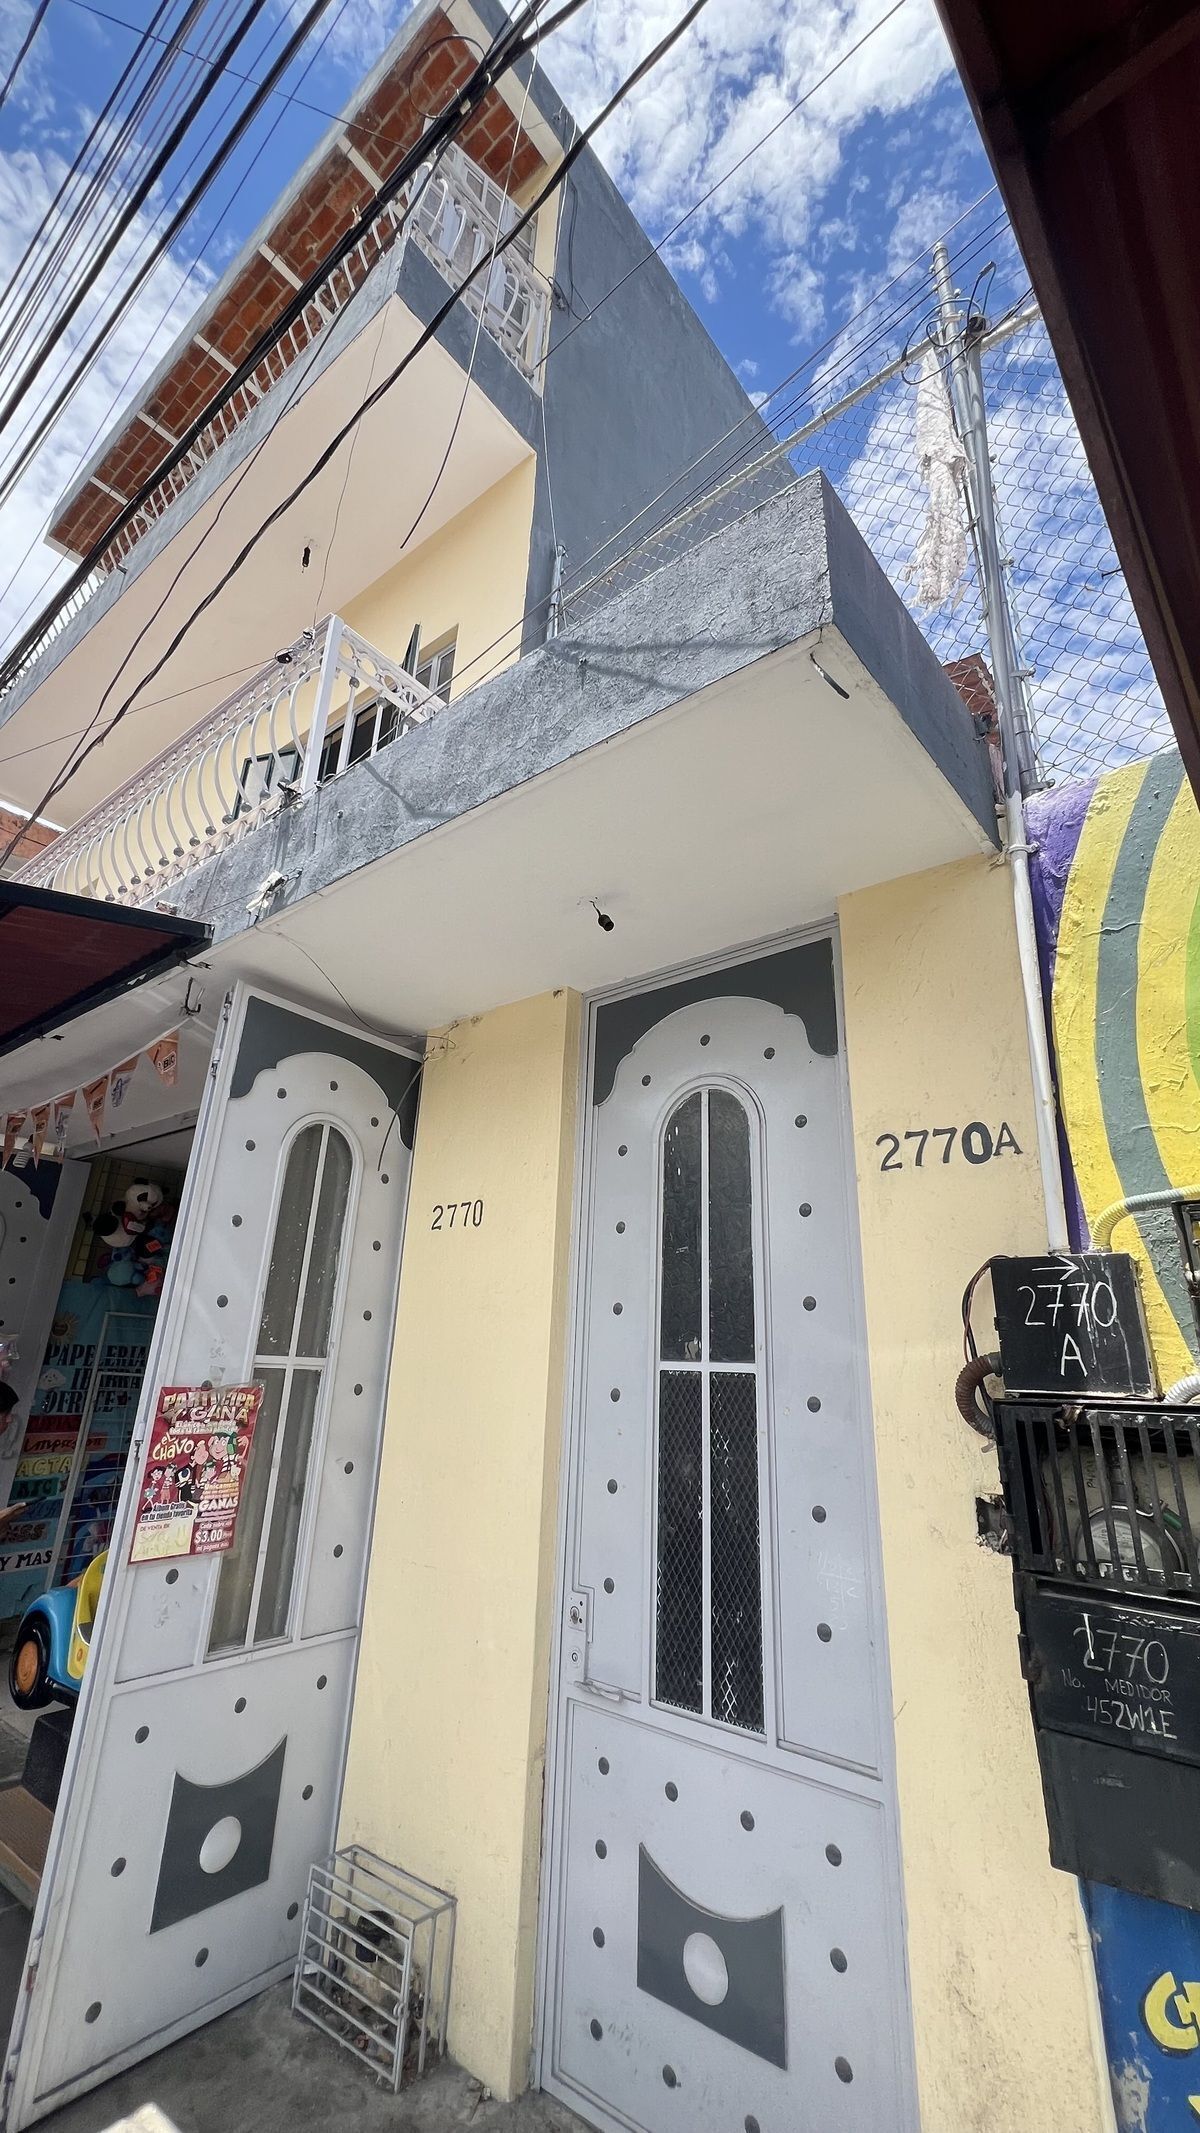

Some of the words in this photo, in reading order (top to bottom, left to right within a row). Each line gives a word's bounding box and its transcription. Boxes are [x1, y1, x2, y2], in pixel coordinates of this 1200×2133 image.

[876, 1121, 1024, 1171] 2770A
[431, 1199, 484, 1231] 2770
[1017, 1280, 1118, 1328] 2770
[42, 1343, 148, 1367] PAPEERIA
[1060, 1333, 1088, 1378] A
[190, 1404, 249, 1425] GANA
[199, 1497, 238, 1512] GANAS
[195, 1528, 223, 1544] $3.00
[15, 1550, 53, 1568] MAS
[1073, 1626, 1170, 1684] 2770
[1104, 1678, 1173, 1705] MEDIDOR
